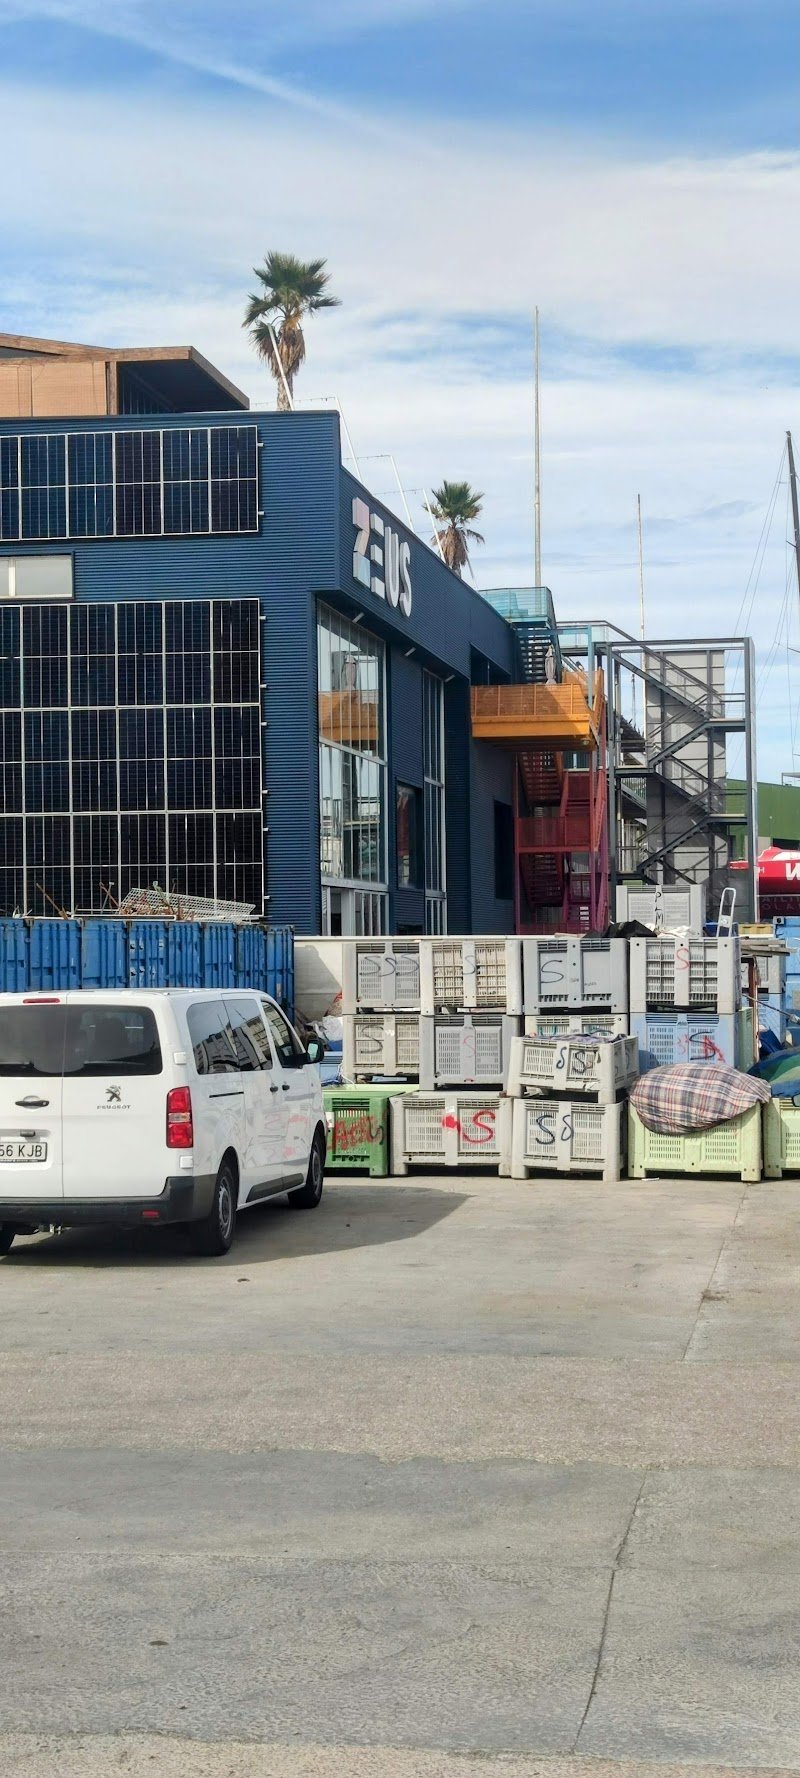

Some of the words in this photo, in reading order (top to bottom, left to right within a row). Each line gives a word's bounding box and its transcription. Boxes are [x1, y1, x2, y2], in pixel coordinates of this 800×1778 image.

[352, 497, 412, 617] ZEUS
[541, 960, 564, 983] S
[676, 948, 691, 970] S
[360, 1024, 384, 1054] S
[463, 1110, 496, 1144] S
[18, 1144, 43, 1157] KJB
